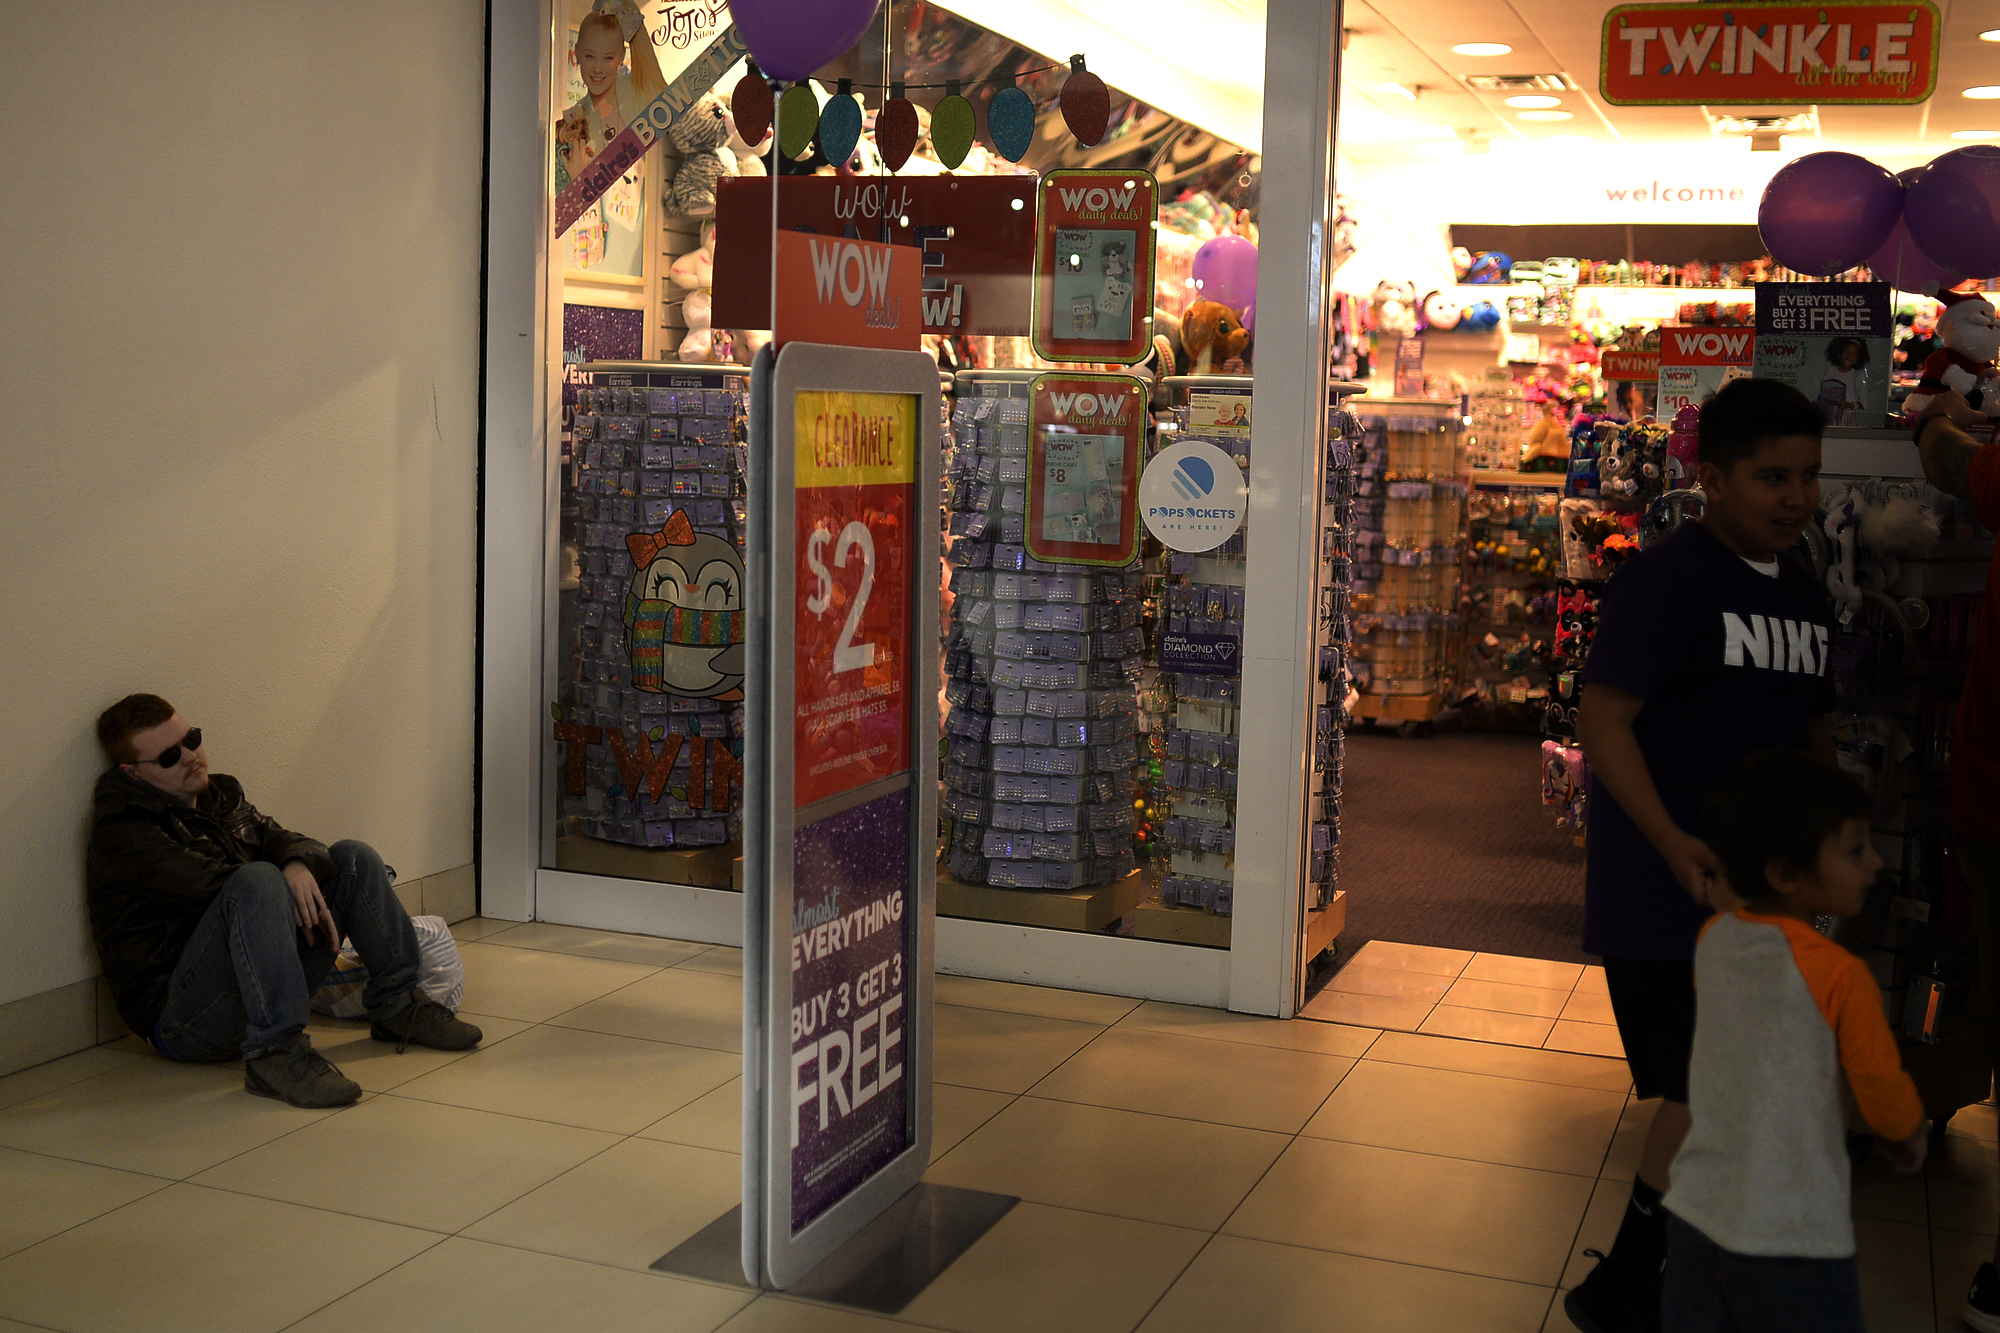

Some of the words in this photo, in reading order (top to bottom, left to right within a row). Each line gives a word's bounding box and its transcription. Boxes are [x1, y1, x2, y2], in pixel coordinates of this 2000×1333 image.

[694, 30, 715, 41] Siwa
[1620, 23, 1914, 76] TWINKLE
[1796, 63, 1824, 86] all
[1831, 64, 1862, 87] the
[1869, 63, 1918, 93] way!
[582, 141, 641, 202] claire's
[1059, 188, 1137, 213] WOW
[1606, 181, 1744, 202] welcome
[1079, 208, 1108, 225] daily
[1111, 207, 1144, 220] deals!
[1064, 232, 1087, 241] WOW
[809, 239, 893, 307] WOW
[1778, 295, 1865, 306] EVERYTHING
[866, 296, 899, 329] deals!
[1773, 308, 1796, 318] BUY
[1800, 308, 1806, 318] 3
[1810, 308, 1871, 330] FREE
[1773, 319, 1796, 329] GET
[1800, 319, 1806, 329] 3
[1674, 333, 1750, 356] WOW
[1763, 345, 1797, 356] WOW
[1606, 355, 1660, 372] TWINK
[608, 378, 632, 387] Earrings
[671, 379, 702, 388] Earrings
[1666, 372, 1692, 380] WOW
[1050, 391, 1126, 418] WOW
[1664, 396, 1690, 410] $10
[1069, 413, 1096, 429] daily
[1100, 413, 1132, 427] deals!
[814, 411, 894, 468] CLEARANCE
[1051, 443, 1073, 451] WOW
[1050, 468, 1066, 483] $8
[1150, 507, 1235, 519] POPSOCKETS
[806, 520, 875, 674] $2
[1164, 643, 1213, 654] DIAMOND
[1164, 652, 1215, 660] COLLECTION
[797, 704, 810, 717] ALL
[811, 692, 849, 713] HANDBAGS
[849, 689, 865, 703] AND
[825, 709, 855, 728] SCARVES
[862, 704, 878, 716] HATS
[554, 722, 744, 813] TWIN
[791, 890, 902, 972] EVERYTHING
[791, 989, 832, 1043] BUY
[836, 982, 850, 1018] 3
[856, 959, 889, 1008] GET
[892, 954, 902, 986] 3
[791, 992, 902, 1150] FREE
